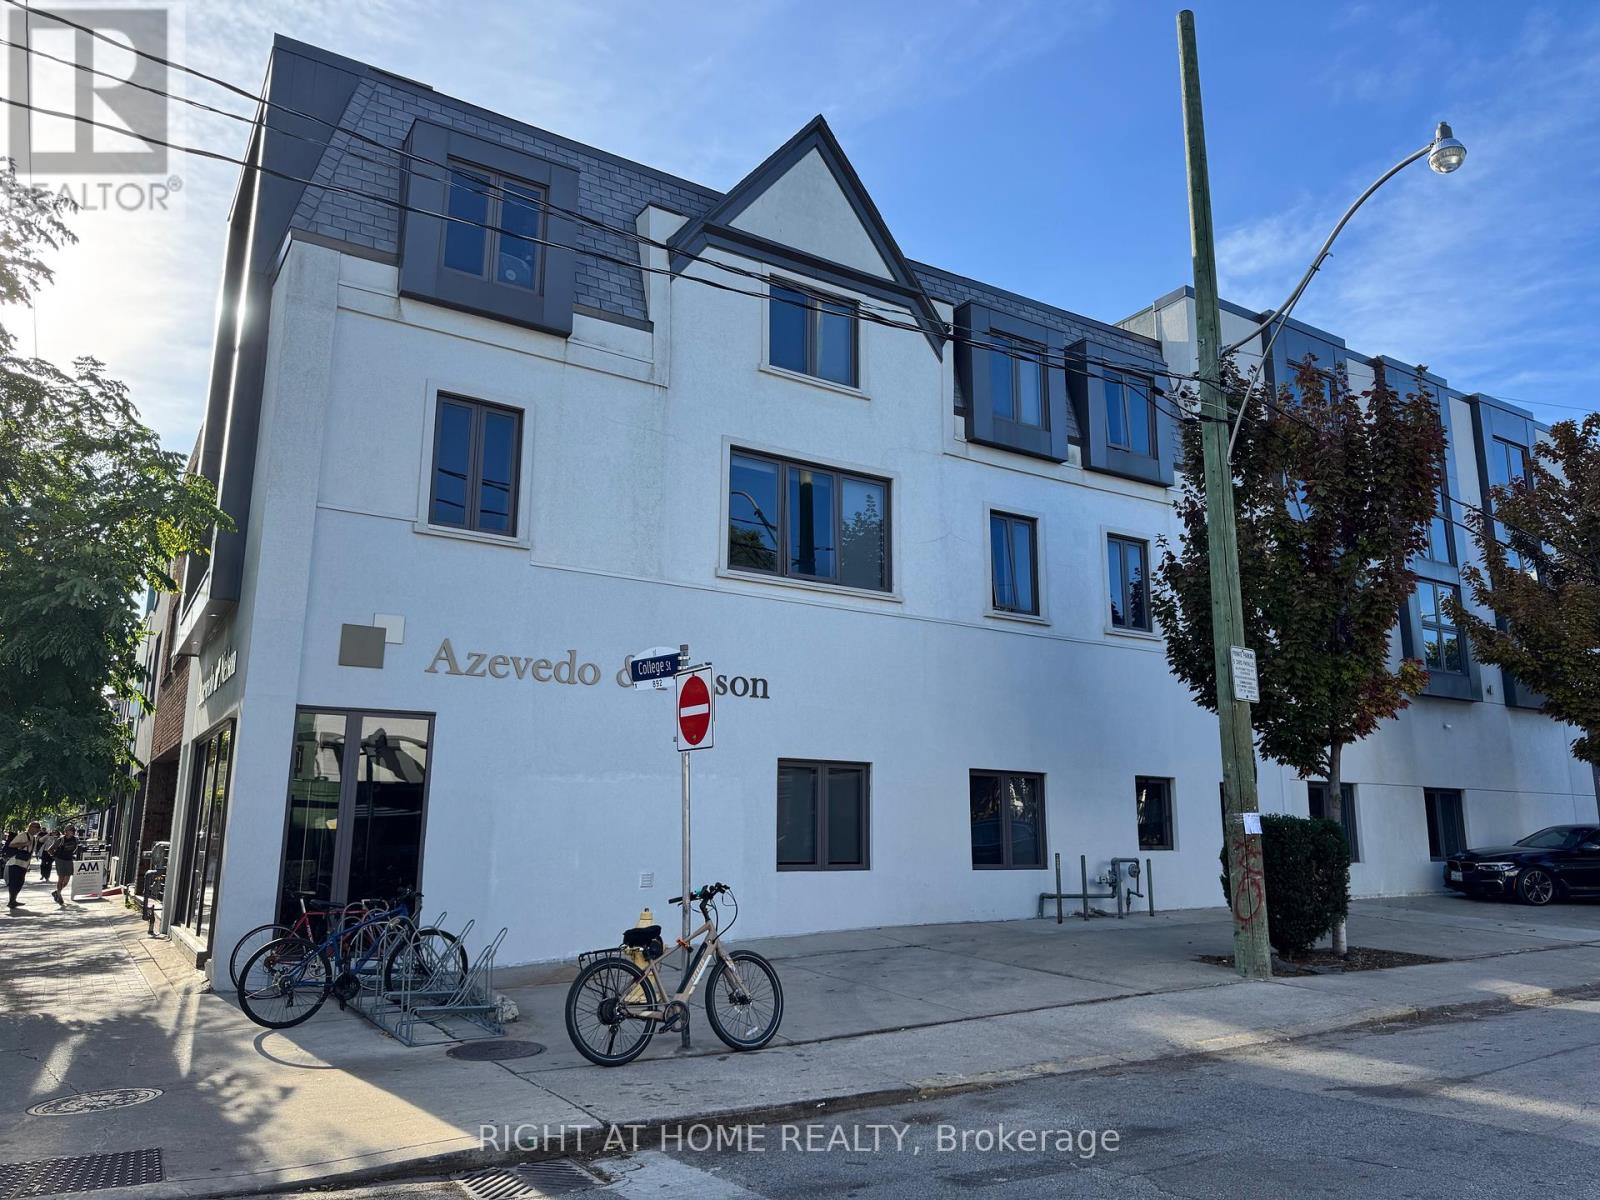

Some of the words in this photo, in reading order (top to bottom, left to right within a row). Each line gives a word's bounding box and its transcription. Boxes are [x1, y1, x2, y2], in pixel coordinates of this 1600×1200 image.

[424, 638, 601, 686] Azevedo
[638, 660, 664, 676] College
[652, 679, 663, 688] 892
[78, 862, 99, 872] AM
